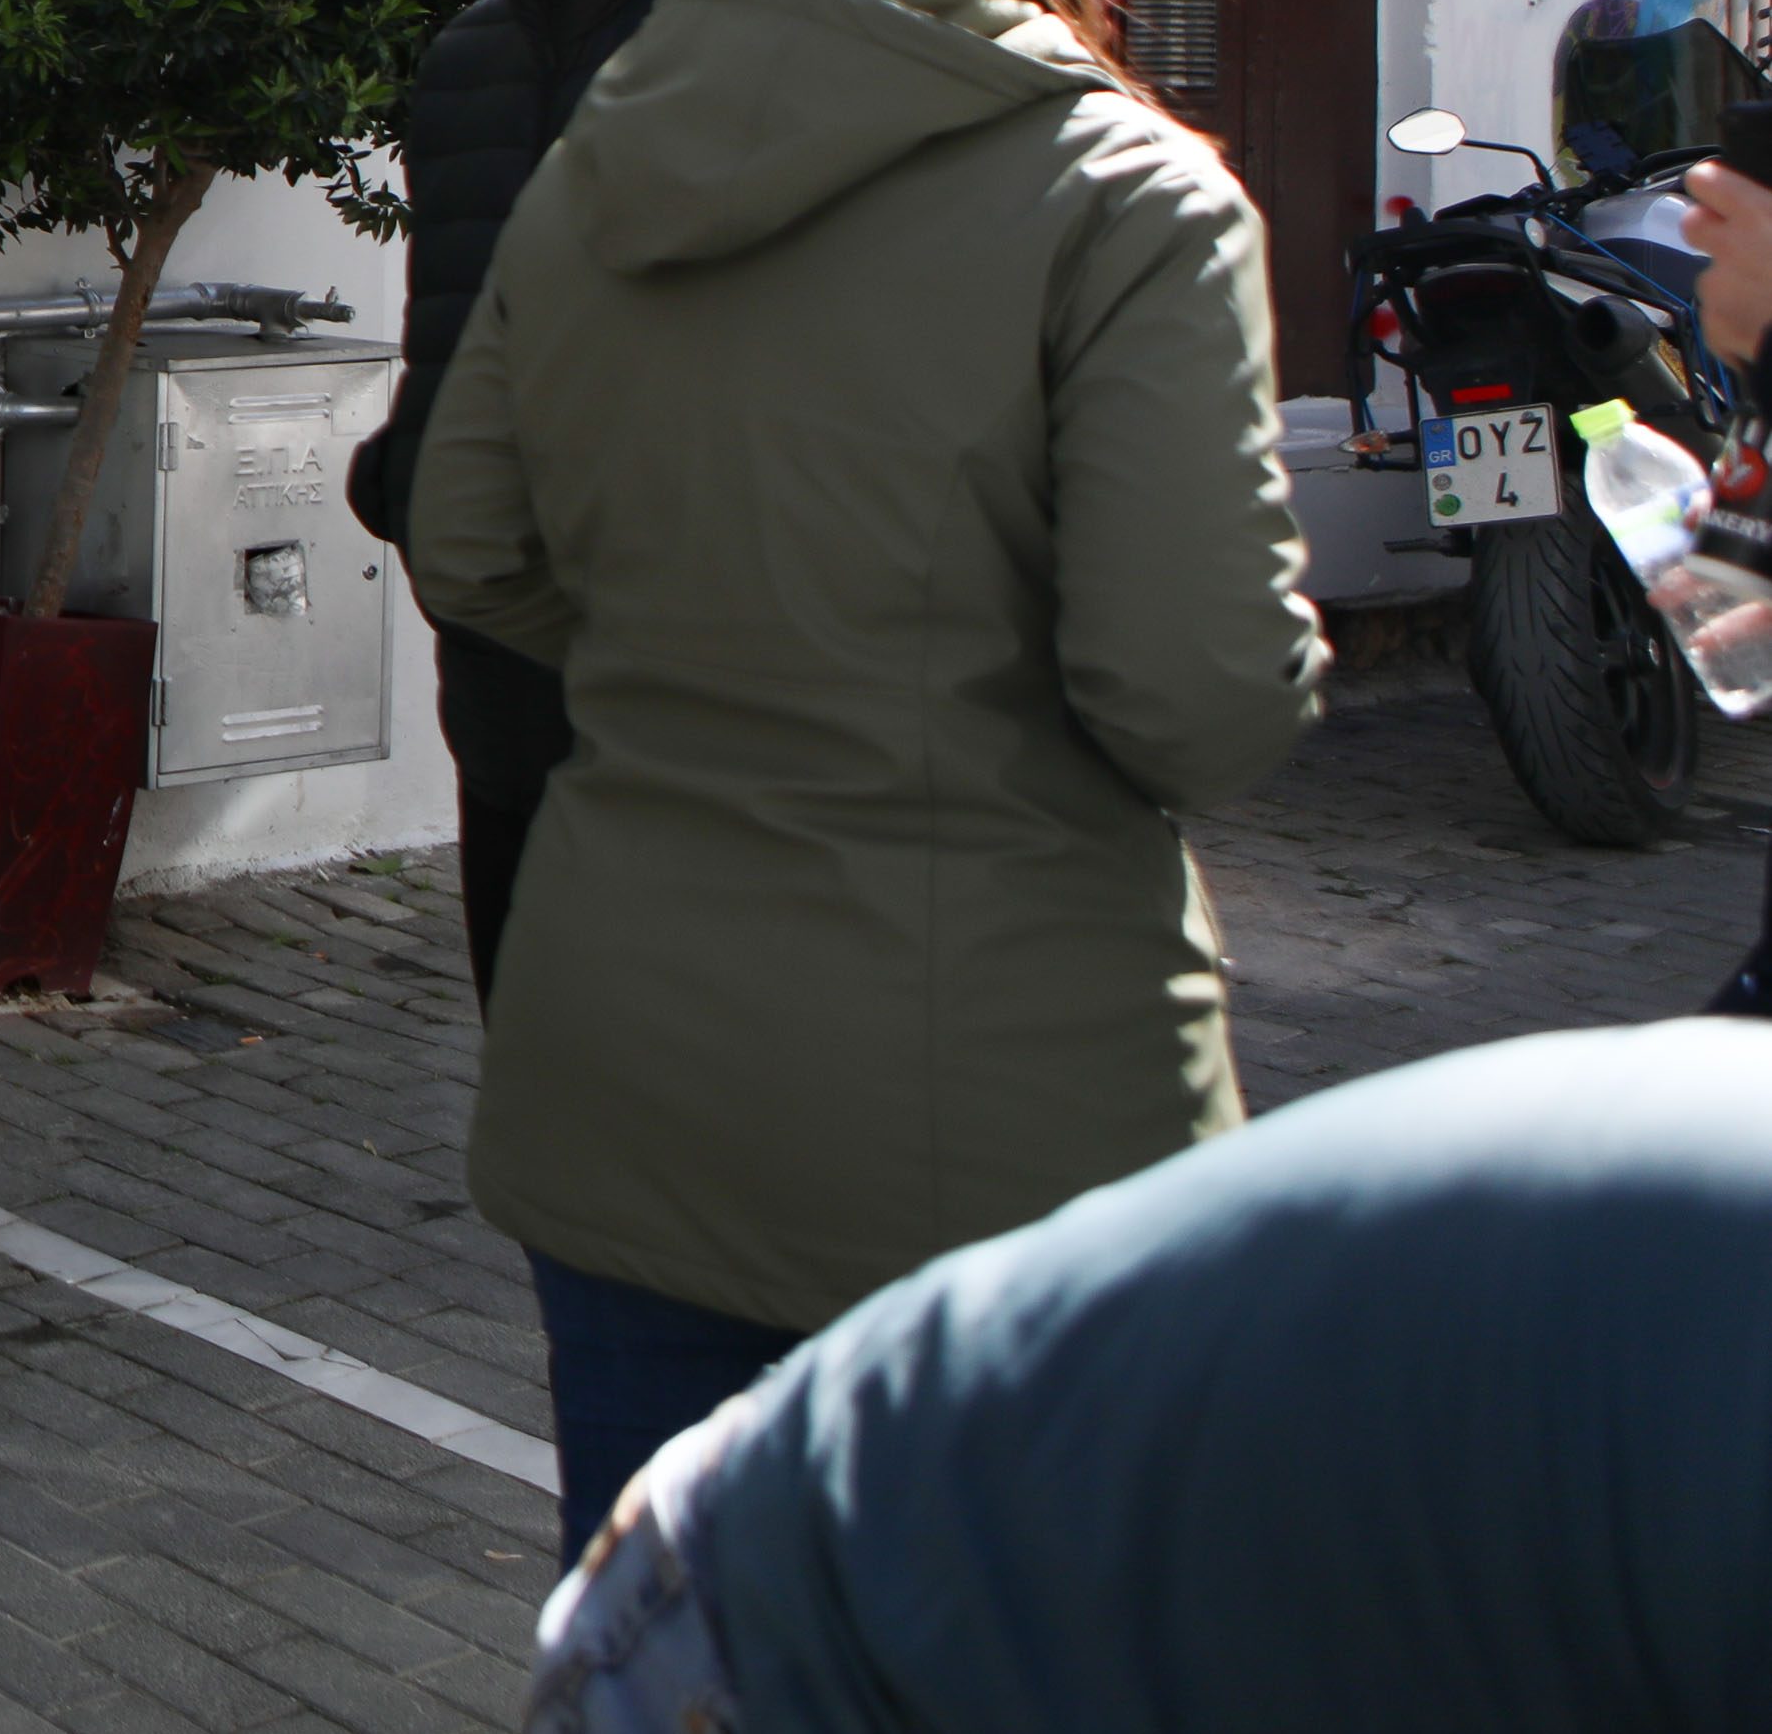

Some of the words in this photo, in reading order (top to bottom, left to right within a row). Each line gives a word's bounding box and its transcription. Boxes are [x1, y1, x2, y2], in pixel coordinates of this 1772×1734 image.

[1457, 415, 1547, 461] OYZ
[1428, 449, 1453, 464] GR
[233, 480, 323, 511] ΑΤΤΙΚΗΣ
[1495, 471, 1519, 508] 4
